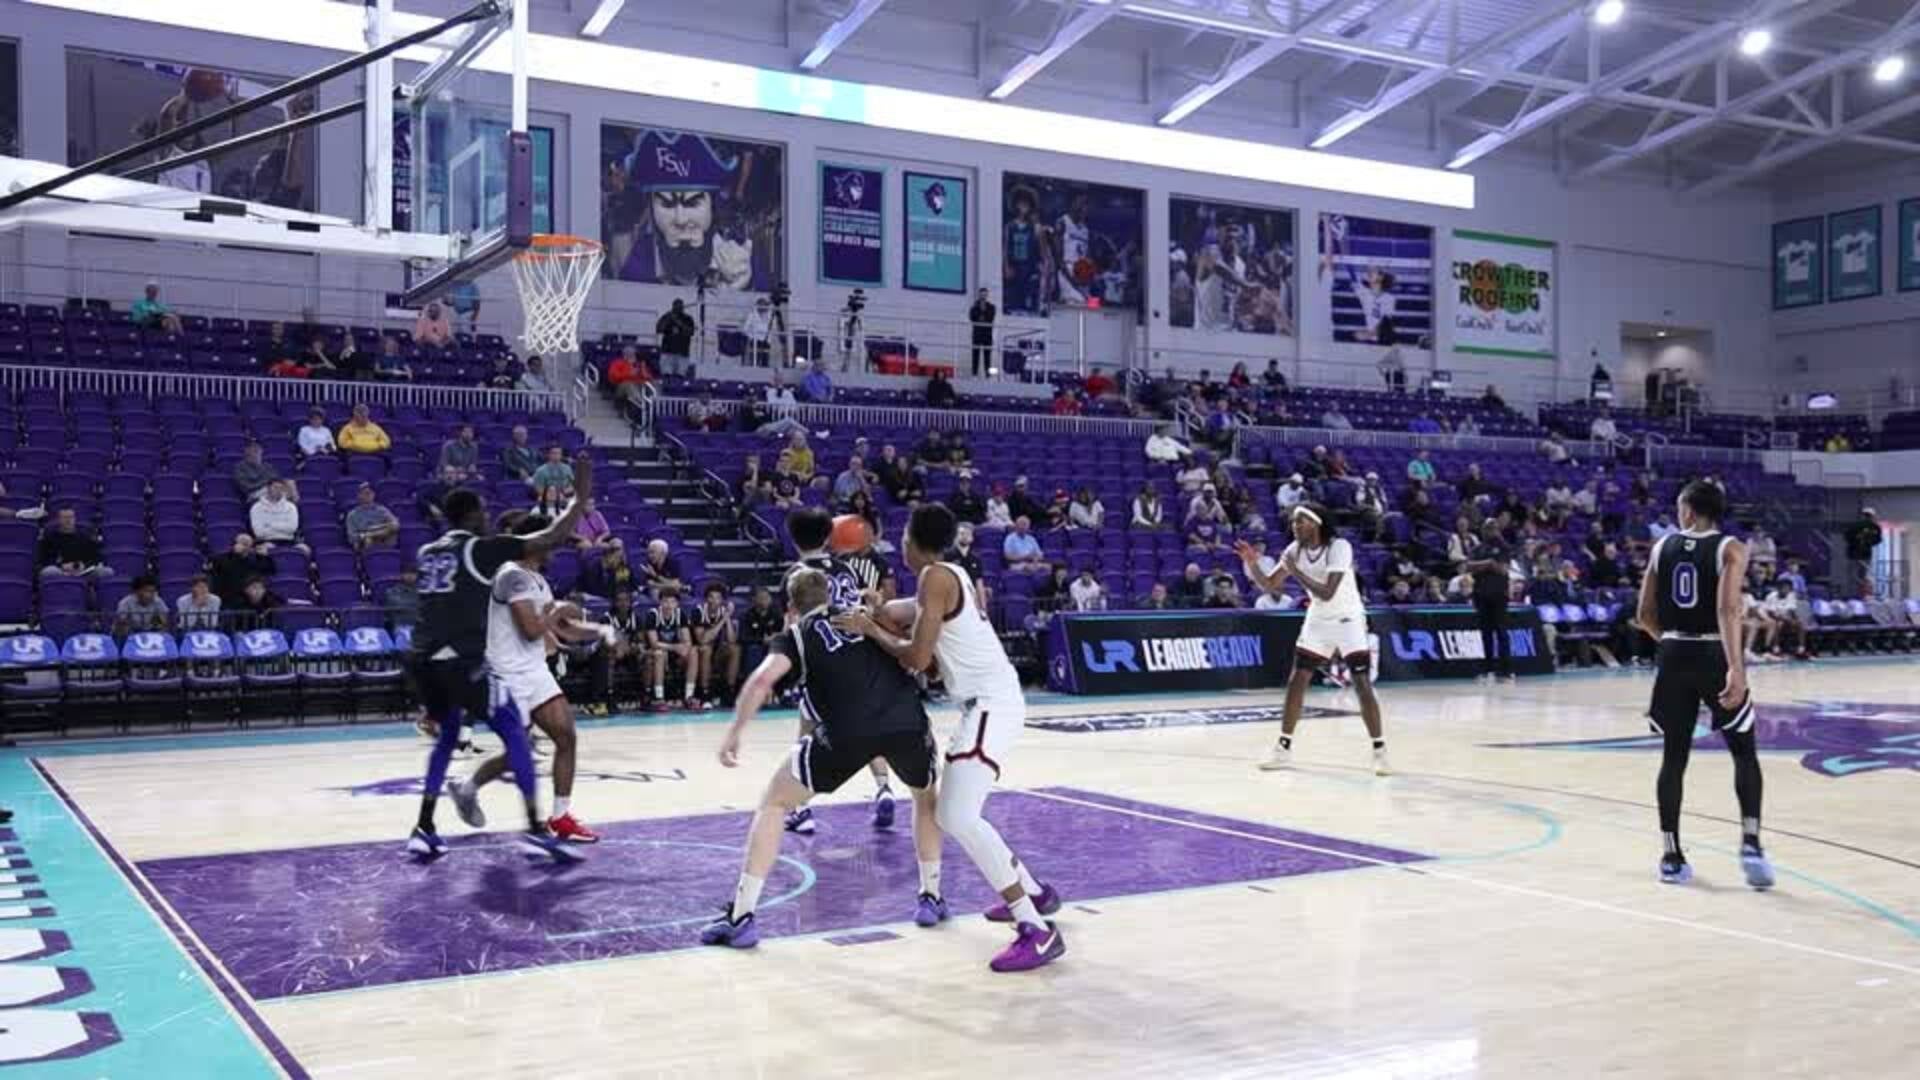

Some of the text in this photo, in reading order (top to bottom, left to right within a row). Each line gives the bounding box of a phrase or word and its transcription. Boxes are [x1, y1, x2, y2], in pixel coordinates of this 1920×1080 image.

[656, 147, 690, 176] FSW
[1460, 285, 1540, 313] ROOFING
[1672, 561, 1699, 609] 0
